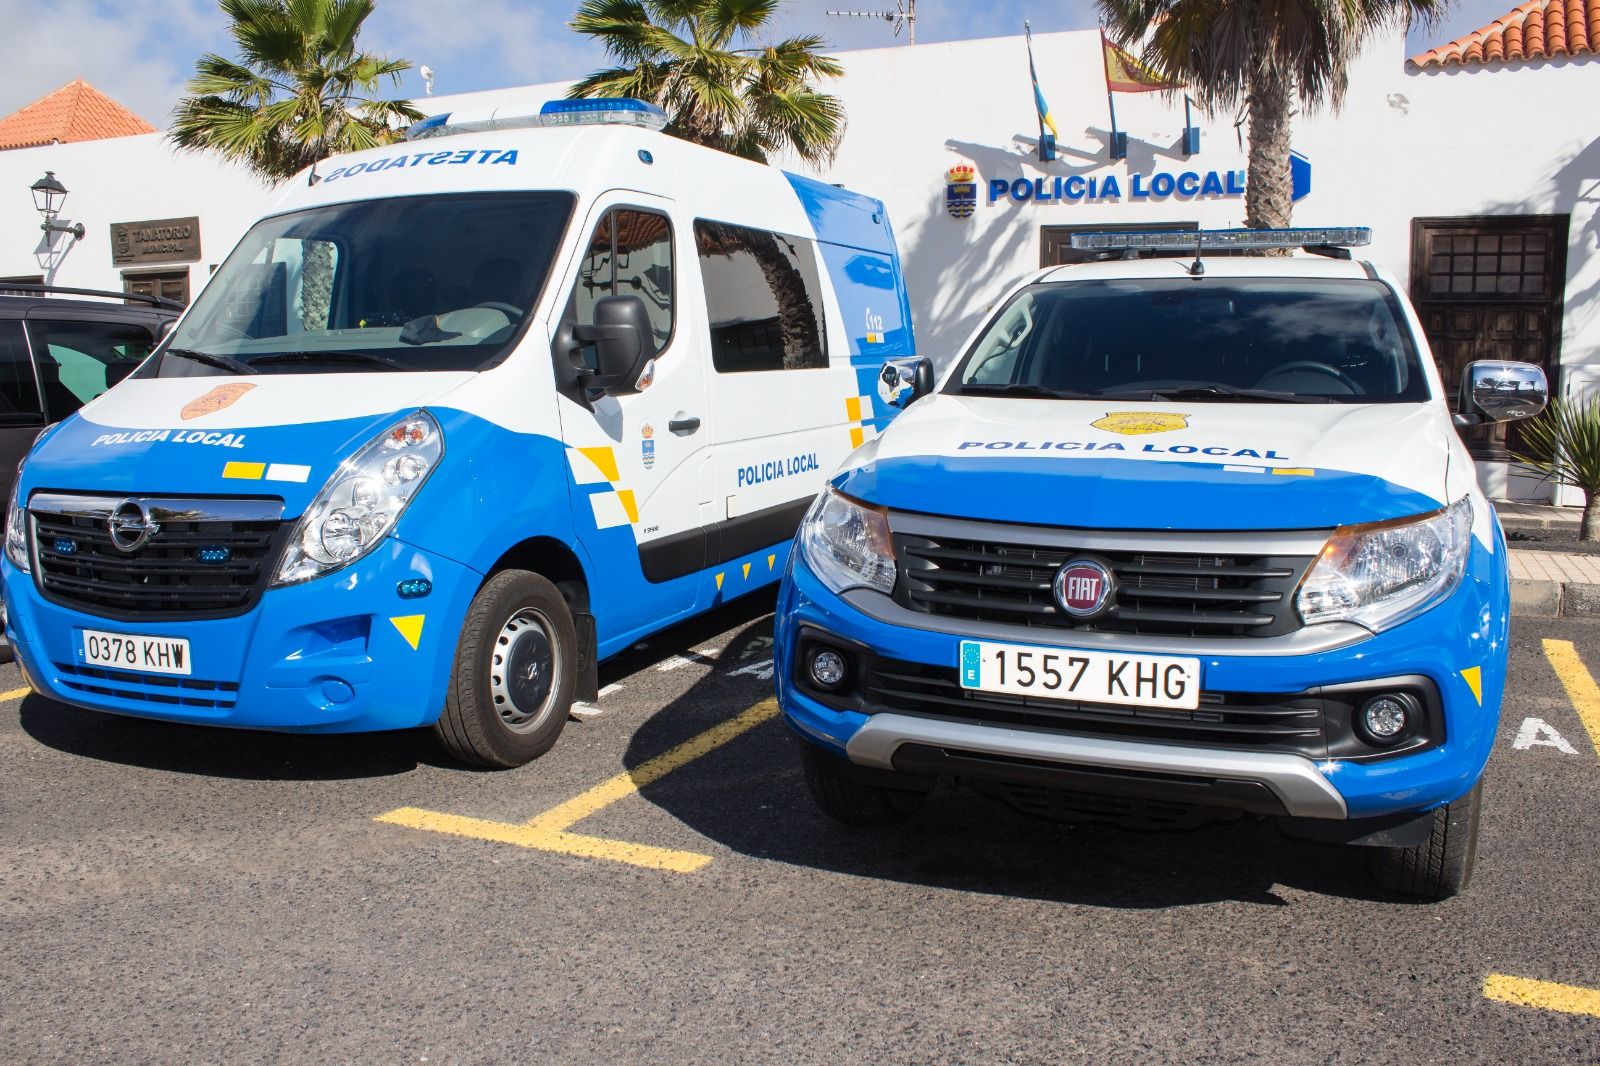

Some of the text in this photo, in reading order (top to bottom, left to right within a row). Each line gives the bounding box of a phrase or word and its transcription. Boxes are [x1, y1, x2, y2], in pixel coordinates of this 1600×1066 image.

[989, 170, 1245, 202] POLICIA LOCAL
[132, 226, 192, 242] TANATORIO
[143, 242, 184, 254] MUNICIPAL
[870, 315, 883, 330] 112
[91, 430, 246, 449] POLICIA LOCAL
[958, 441, 1289, 460] POLICIA LOCAL
[738, 453, 819, 487] POLICIA LOCAL
[1067, 576, 1099, 601] FIAT
[89, 636, 184, 668] 0378 KHW
[967, 669, 976, 681] E
[995, 650, 1187, 700] 1557 KHG
